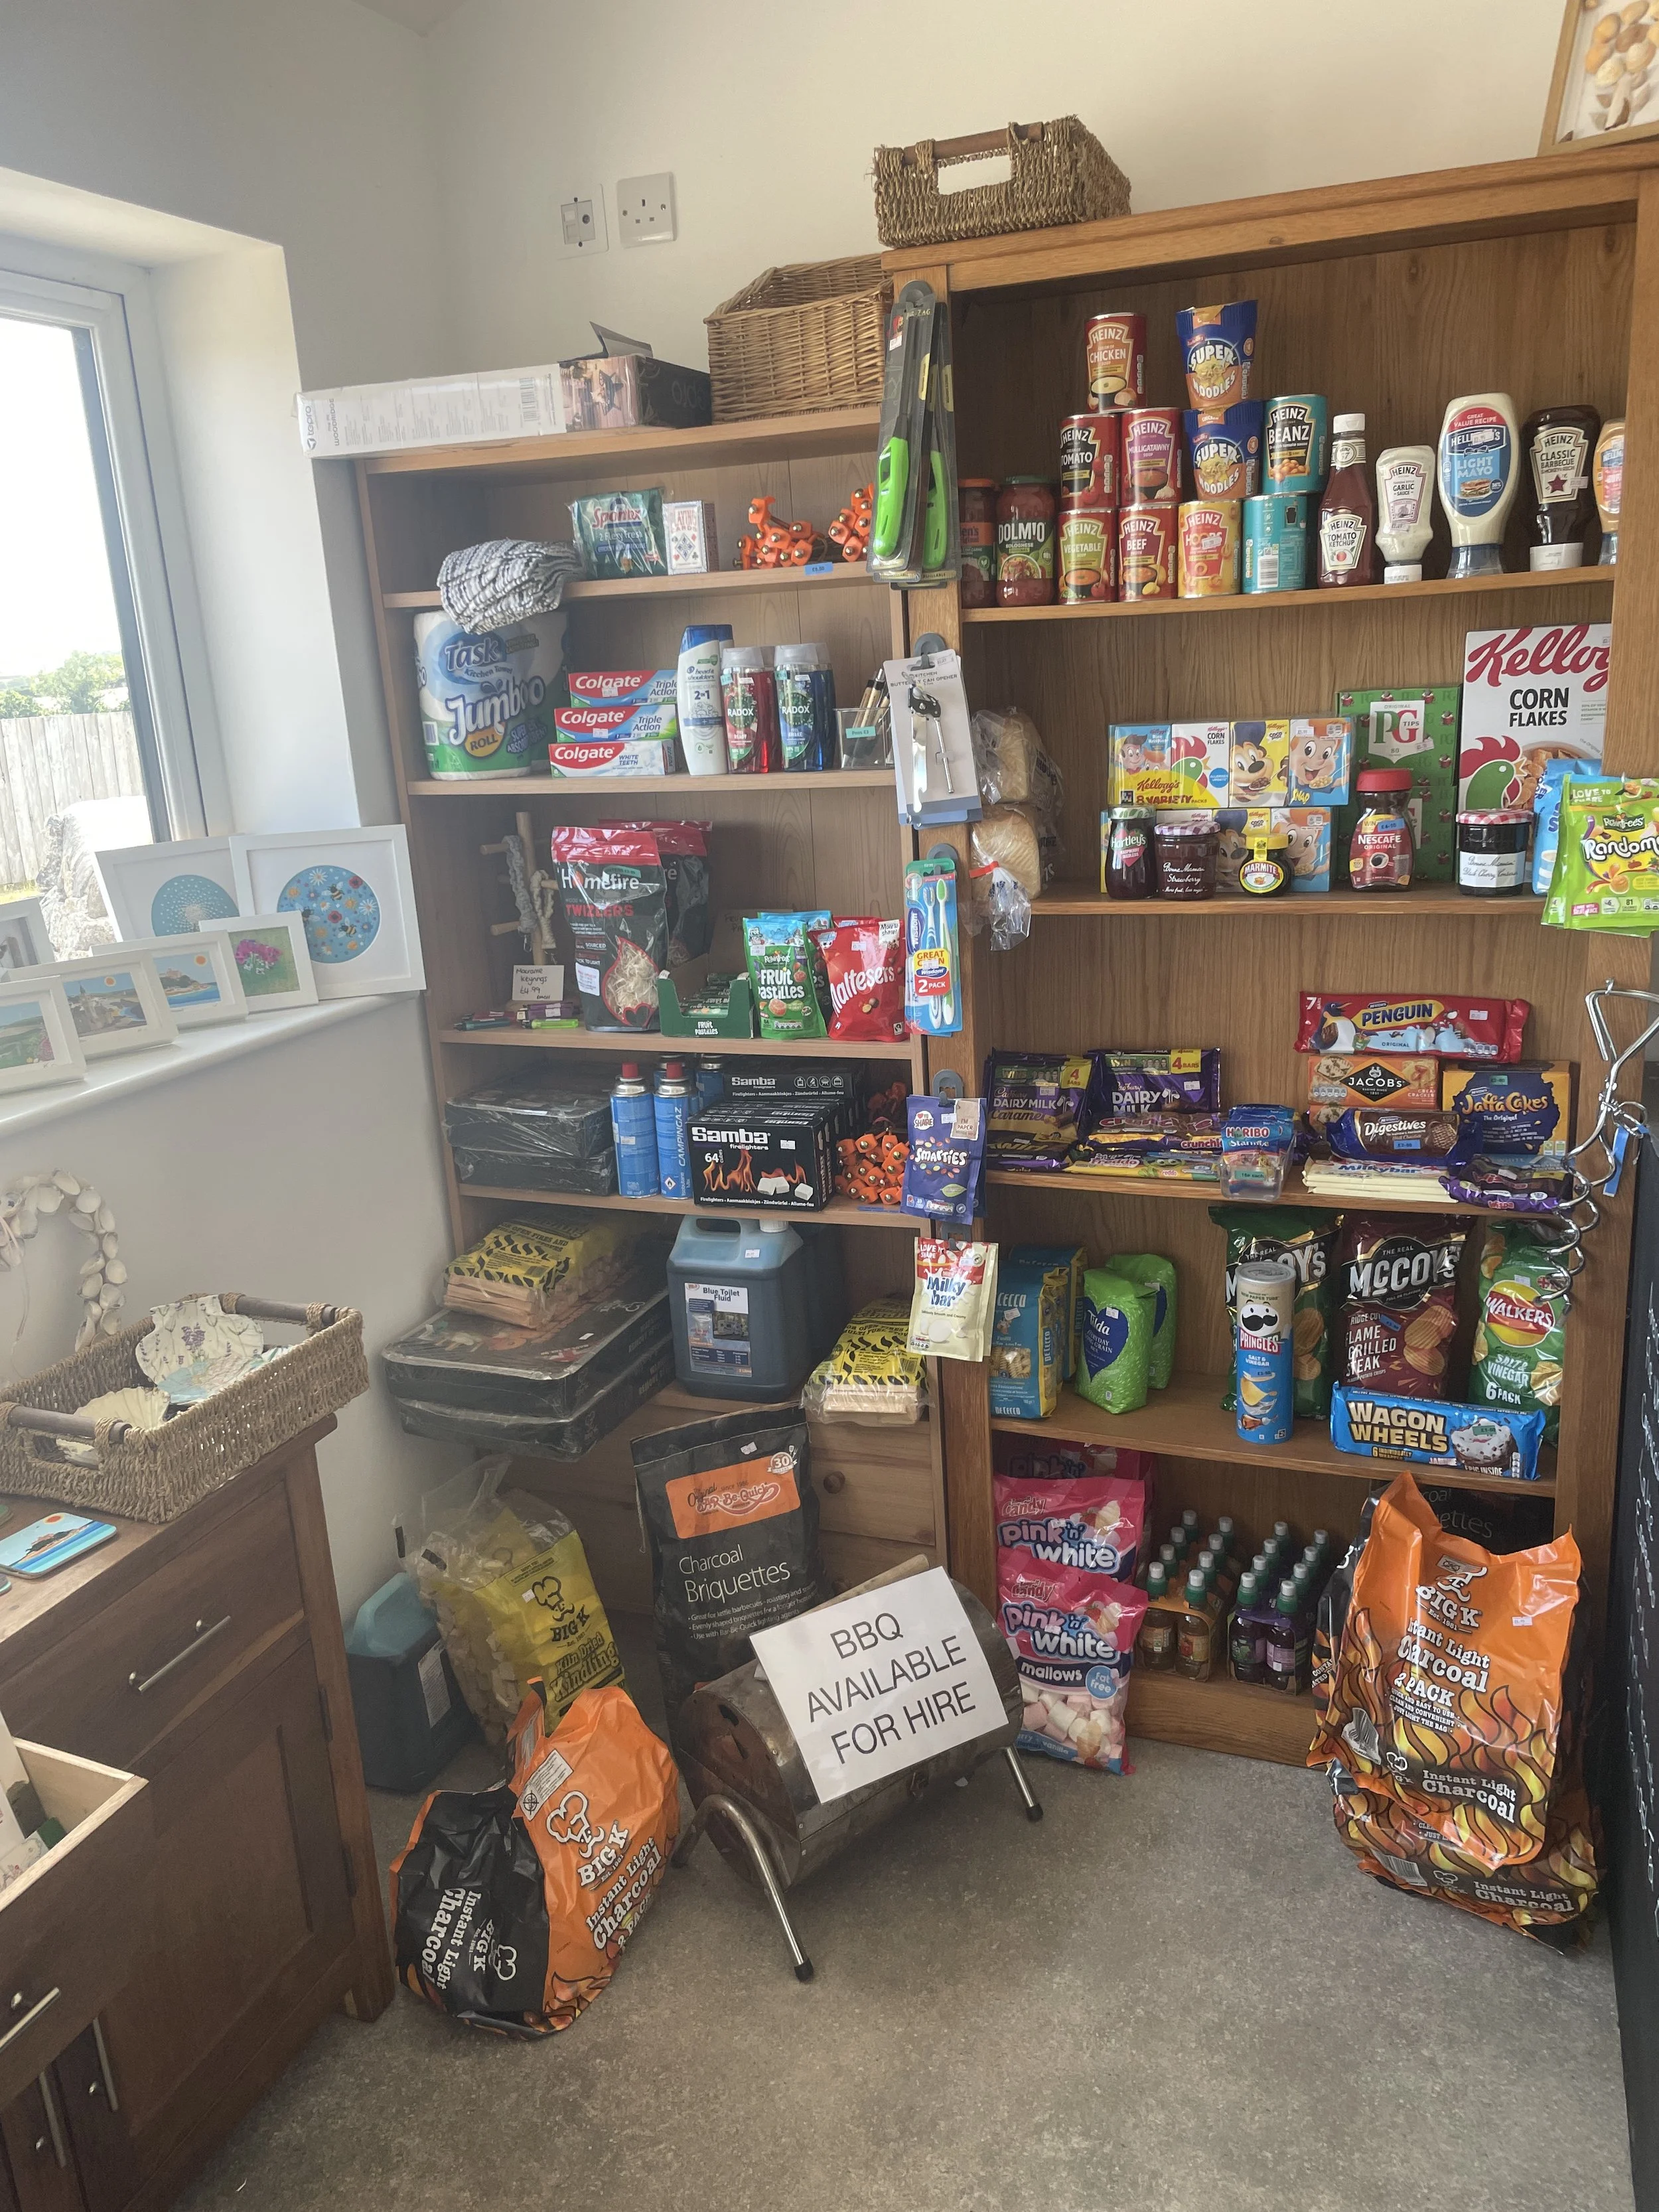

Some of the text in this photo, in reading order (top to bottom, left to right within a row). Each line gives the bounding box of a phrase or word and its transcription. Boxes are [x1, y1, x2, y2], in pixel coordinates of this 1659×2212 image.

[1092, 329, 1122, 343] HEINZ
[1090, 348, 1126, 364] CHICKEN
[1190, 344, 1235, 371] SUPER
[1272, 407, 1305, 421] HEINZ
[1454, 415, 1496, 428] VALUE RECIPE
[1062, 429, 1090, 443] HEINZ
[1133, 422, 1166, 435] HEINZ
[1268, 425, 1309, 443] BEANZ
[1544, 435, 1573, 446] HEINZ
[1062, 451, 1093, 465] TOMATO
[1195, 443, 1240, 467] SUPER
[1457, 457, 1493, 469] LIGHT
[1540, 449, 1575, 461] CLASSIC
[1541, 458, 1575, 468] BARBECUE
[1392, 467, 1417, 476] HEINZ
[1458, 466, 1493, 477] MAYO
[1393, 482, 1415, 491] GARLIC
[1124, 520, 1154, 532] HEINZ
[1188, 512, 1220, 526] HEINZ
[1331, 520, 1354, 530] HEINZ
[1066, 521, 1098, 535] HEINZ
[1127, 538, 1147, 551] BEEF
[1327, 532, 1356, 542] TOMATO
[1064, 543, 1102, 553] VEGETABLE
[445, 637, 499, 672] Task
[1510, 688, 1569, 710] CORN
[447, 677, 544, 745] Jumbo
[561, 711, 624, 726] Colgate
[727, 708, 753, 717] RADOX
[782, 705, 810, 715] RADOX
[1510, 710, 1567, 727] FLAKES
[638, 717, 662, 726] Triple
[1374, 709, 1418, 745] PG
[469, 735, 498, 751] ROLL
[555, 745, 614, 763] Colgate
[1137, 778, 1180, 794] Kellogg's
[1572, 788, 1599, 798] LOVE
[1112, 834, 1146, 848] Hartley's
[1244, 863, 1277, 874] MARMITE
[1167, 875, 1200, 884] Strawberry
[917, 950, 944, 960] GREAT
[918, 980, 928, 993] 2
[1307, 997, 1317, 1009] 7
[1362, 1003, 1433, 1026] PENGUIN
[1172, 1057, 1182, 1069] 4
[732, 1077, 775, 1086] Samba
[1070, 1069, 1079, 1080] 4
[993, 1098, 1056, 1110] DAIRY MILK
[1112, 1092, 1161, 1104] DAIRY
[1460, 1092, 1548, 1114] Jaffa Cakes
[675, 1106, 685, 1167] CAMPINGAZ
[692, 1127, 768, 1144] Samba
[1364, 1120, 1426, 1142] Digestives
[705, 1153, 719, 1163] 64
[1262, 1247, 1276, 1256] REAL
[928, 1277, 966, 1295] Milky
[931, 1290, 956, 1307] bar
[1486, 1297, 1553, 1327] WALKERS
[1088, 1309, 1110, 1335] Tilda
[1094, 1341, 1112, 1354] GRAIN
[1240, 1328, 1279, 1353] PRINGLES
[1348, 1338, 1396, 1360] GRILLED
[1496, 1354, 1518, 1368] SALT
[1487, 1362, 1529, 1386] VINEGAR
[1486, 1382, 1497, 1400] 6
[1498, 1390, 1521, 1404] PACK
[1348, 1402, 1445, 1434] WAGON
[1350, 1424, 1449, 1453] WHEELS
[773, 1457, 791, 1469] 30
[1003, 1520, 1062, 1547] pink
[679, 1544, 744, 1575] Charcoal
[1035, 1542, 1116, 1568] white
[685, 1562, 791, 1603] Briquettes
[732, 1593, 790, 1613] barbecues roasting
[1415, 1584, 1480, 1628] BIG K
[692, 1621, 711, 1630] Evenly
[1428, 1609, 1459, 1630] Est. 1981
[551, 1619, 578, 1642] BIG
[830, 1612, 903, 1660] BBQ
[555, 1632, 604, 1674] Kiln Dried
[1034, 1630, 1115, 1659] white
[1446, 1638, 1490, 1669] Light
[549, 1642, 620, 1702] Kindling
[806, 1635, 968, 1723] AVAILABLE
[1021, 1661, 1083, 1682] mallows
[1096, 1672, 1110, 1683] fat
[1090, 1680, 1112, 1693] free
[1394, 1672, 1455, 1708] 2 PACK
[830, 1682, 976, 1765] FOR HIRE
[1415, 1706, 1455, 1727] CONVENIENT
[1421, 1717, 1434, 1728] THE
[1422, 1769, 1516, 1803] Instant Light
[1422, 1779, 1515, 1824] Charcoal
[578, 1824, 628, 1887] BIG K
[586, 1836, 656, 1931] Instant Light
[1474, 1881, 1569, 1902] Instant Light
[594, 1846, 662, 1950] Charcoal
[1475, 1889, 1575, 1912] Charcoal
[436, 1890, 482, 1990] Instant Light
